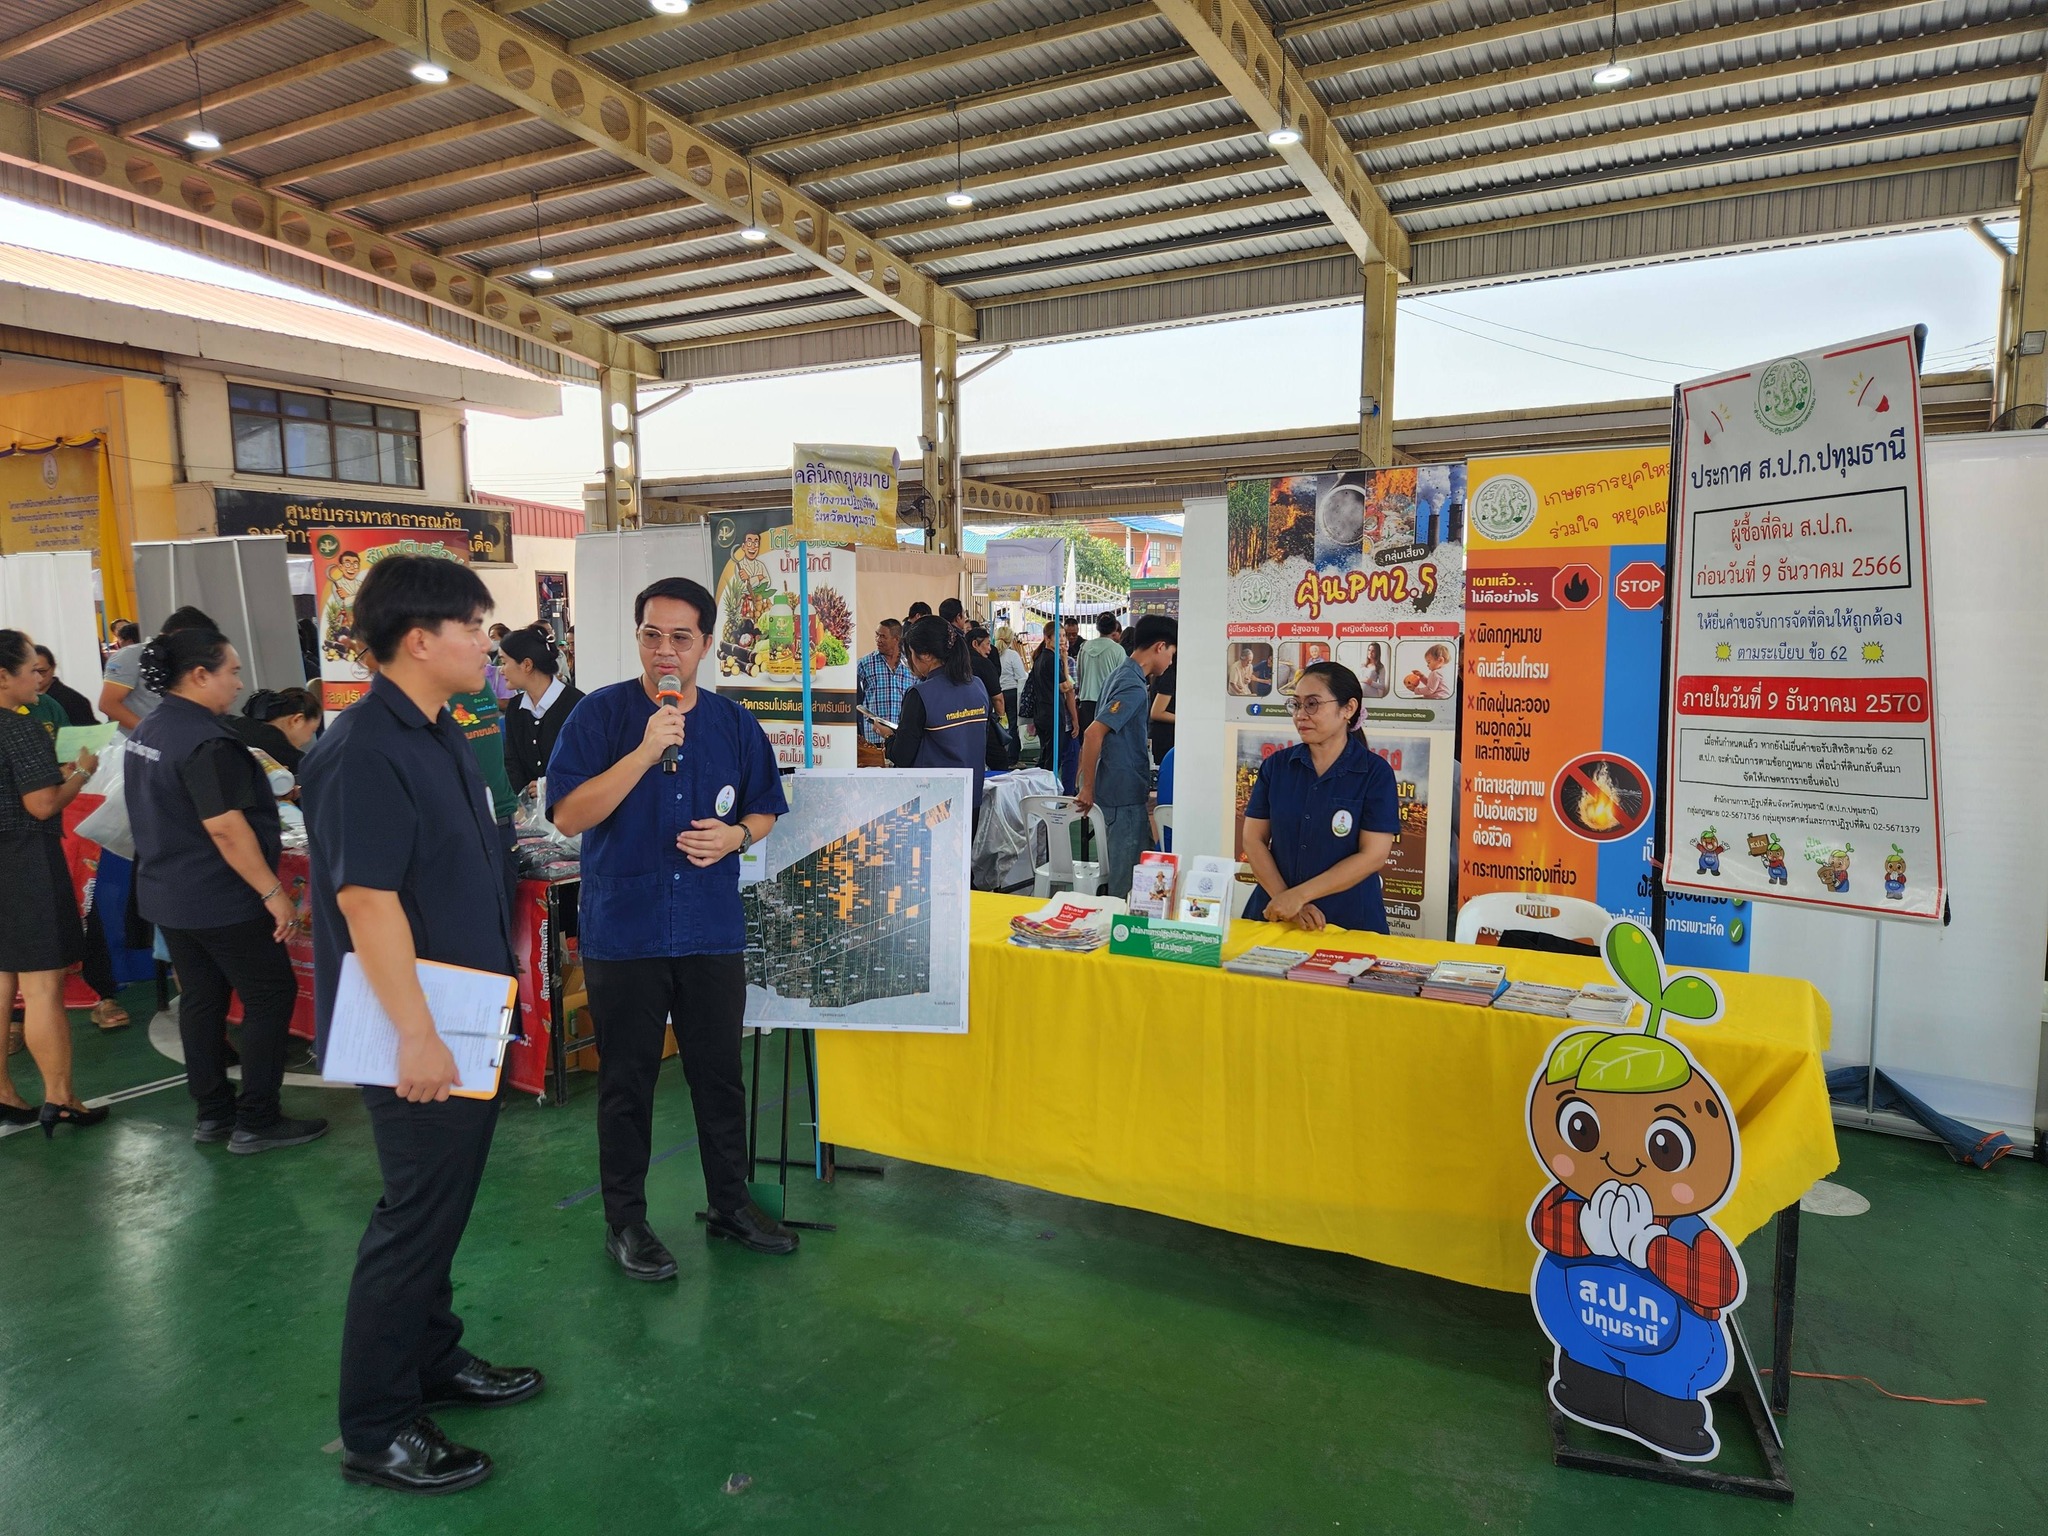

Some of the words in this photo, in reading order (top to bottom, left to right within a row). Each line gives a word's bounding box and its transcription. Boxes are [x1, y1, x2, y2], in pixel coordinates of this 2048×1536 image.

[1691, 460, 1751, 489] ประกาศ
[1759, 427, 1906, 480] ส.ป.ก.ปทุมธานี
[795, 463, 890, 492] คลินิกกฎหมาย
[285, 502, 461, 529] ศูนย์บรรเทาสาธารณภัย
[1550, 515, 1599, 539] ร่วมใจ
[1731, 511, 1793, 550] ผู้ซื้อที่ดิน
[1801, 513, 1852, 536] ส.ป.ก.
[1384, 544, 1425, 563] กลุ่มเสี่ยง
[1697, 555, 1755, 586] ก่อนวันที่
[1761, 564, 1771, 583] 9
[1777, 557, 1843, 582] ธันวาคม
[1851, 554, 1901, 577] 2566
[1471, 589, 1538, 604] ไม่ดีอย่างไร
[1620, 580, 1661, 593] STOP
[1228, 624, 1274, 634] ผู้มีโรคประจำตัว
[1291, 624, 1320, 635] ผู้สูงอายุ
[1342, 624, 1388, 634] หญิงตั้งครรภ์
[1420, 624, 1434, 633] เด็ก
[1697, 607, 1902, 633] ให้ยื่นคำขอรับการจัดที่ดินให้ถูกต้อง
[1737, 643, 1804, 660] ตามระเบียบ
[1809, 641, 1824, 660] ข้อ
[1830, 645, 1847, 660] 62
[1477, 650, 1549, 678] ดินเสื่อมโทรม
[1476, 691, 1550, 718] เกิดฝุ่นละออง
[1682, 681, 1761, 709] ภายในวันที่
[1768, 693, 1778, 709] 9
[1786, 687, 1856, 713] ธันวาคม
[1865, 694, 1922, 713] 2570
[1476, 717, 1531, 737] หมอกควัน
[1475, 739, 1530, 762] และก๊าซพิษ
[1881, 746, 1893, 756] 62
[1815, 759, 1901, 774] เพื่อนำที่ดินกลับคืนมา
[1474, 771, 1545, 800] ทำลายสุขภาพ
[1743, 771, 1839, 788] จัดให้เกษตรกรรายอื่นต่อไป
[1473, 795, 1537, 822] เป็นอันตราย
[1721, 810, 1760, 821] 02-5671736
[1873, 822, 1921, 834] 02-5671379
[1473, 824, 1511, 847] ต่อชีวิต
[1472, 858, 1577, 885] กระทบการท่องเที่ยว
[1402, 888, 1422, 896] 1764
[1579, 1280, 1669, 1325] ส.ป.ก.
[1581, 1307, 1659, 1346] ปทุมธานี
